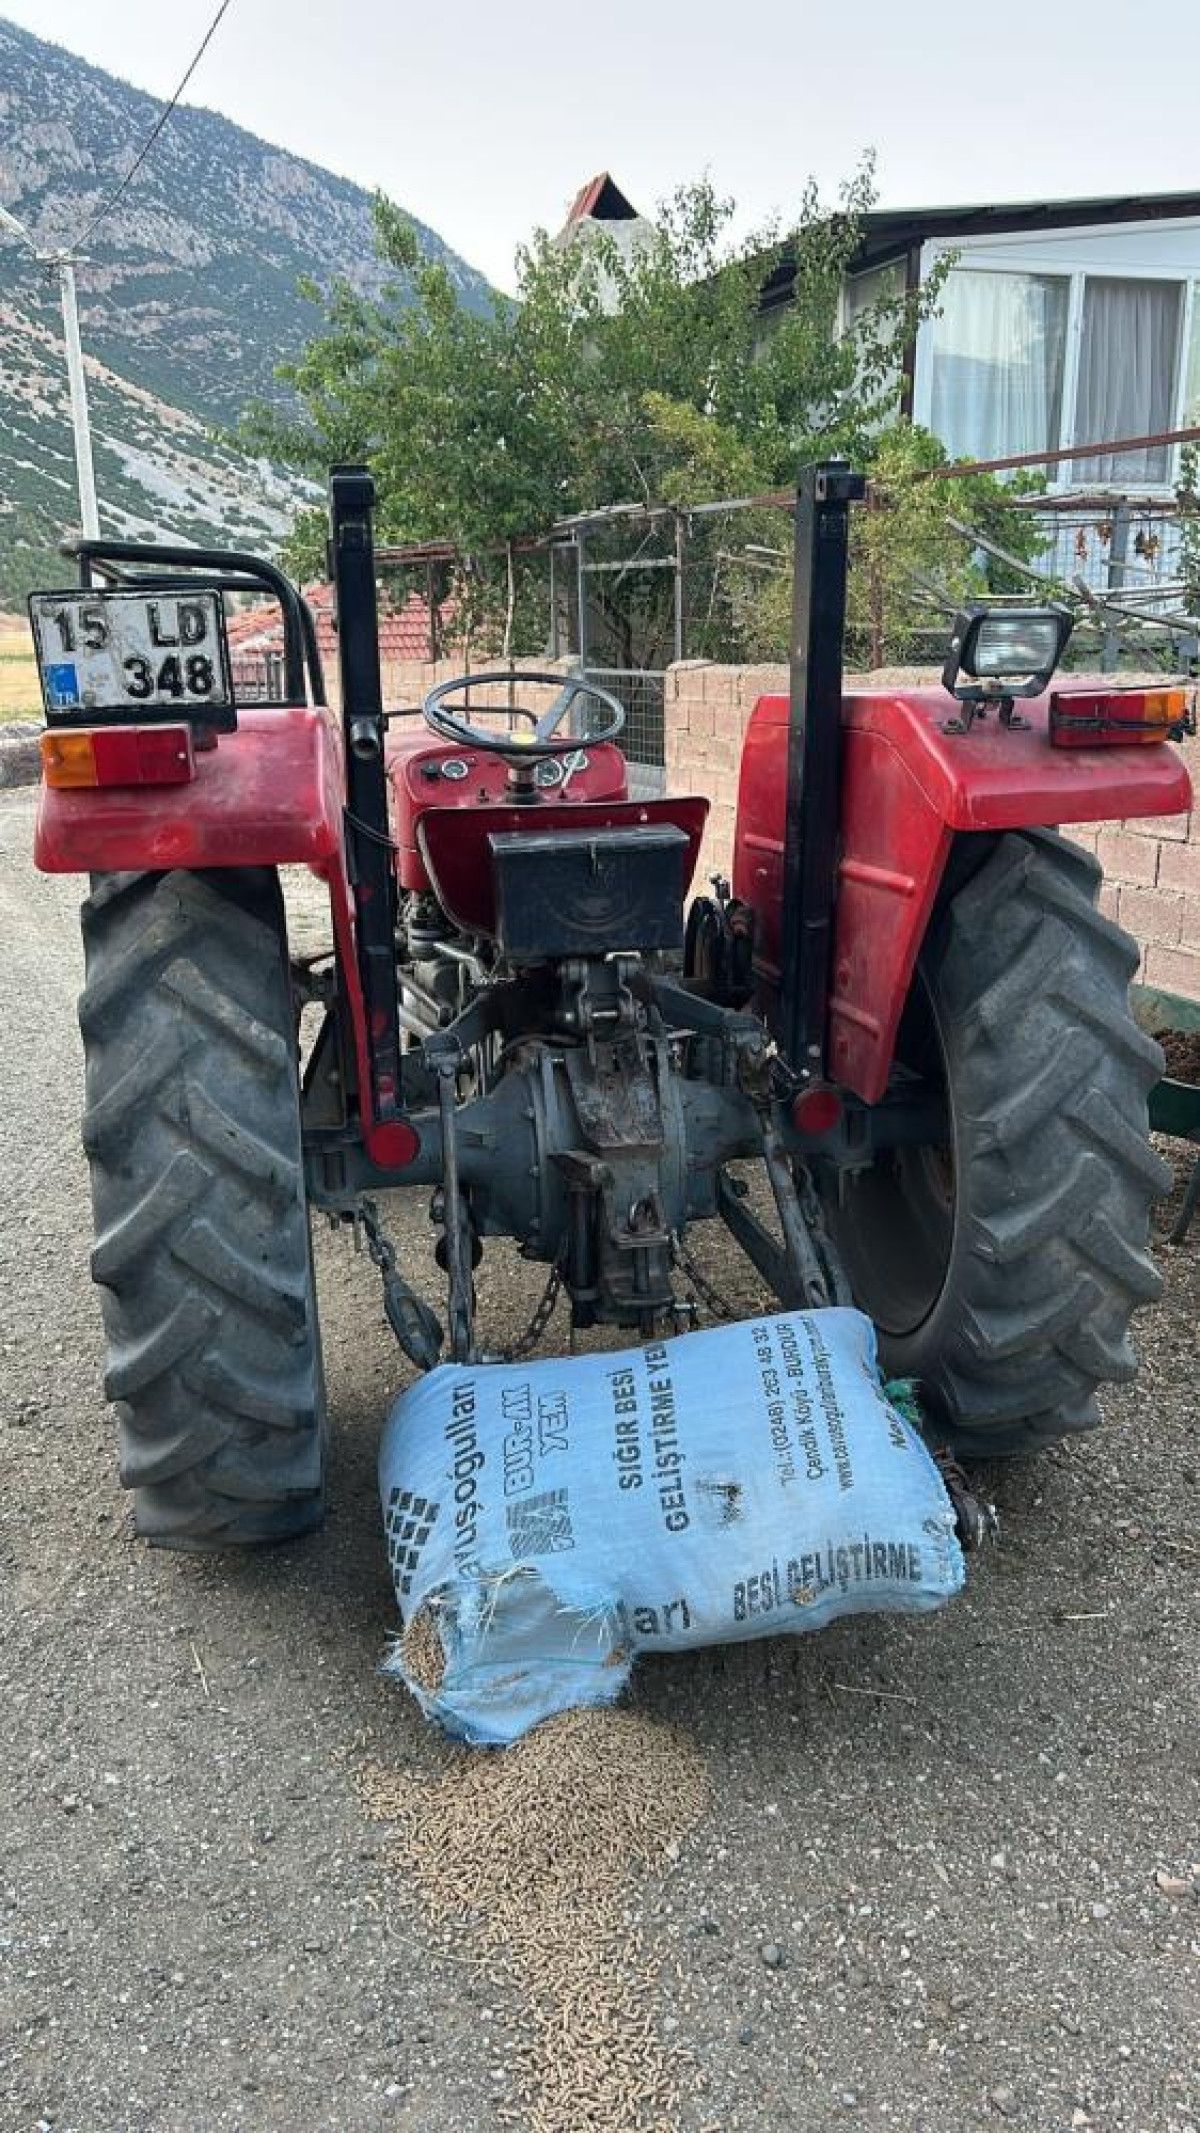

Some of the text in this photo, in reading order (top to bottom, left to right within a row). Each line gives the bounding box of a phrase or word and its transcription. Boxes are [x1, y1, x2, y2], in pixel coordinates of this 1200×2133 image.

[54, 601, 209, 651] 15 LD
[56, 691, 74, 705] TR
[123, 654, 214, 699] 348
[775, 1322, 804, 1378] BURDUR
[502, 1383, 534, 1497] BUR-AK
[538, 1390, 568, 1456] YEM
[606, 1368, 642, 1490] SIĞIR BESİ
[647, 1377, 690, 1532] GELİŞTİRME
[734, 1556, 782, 1621] BESİ
[786, 1532, 922, 1595] GELİŞTİRME
